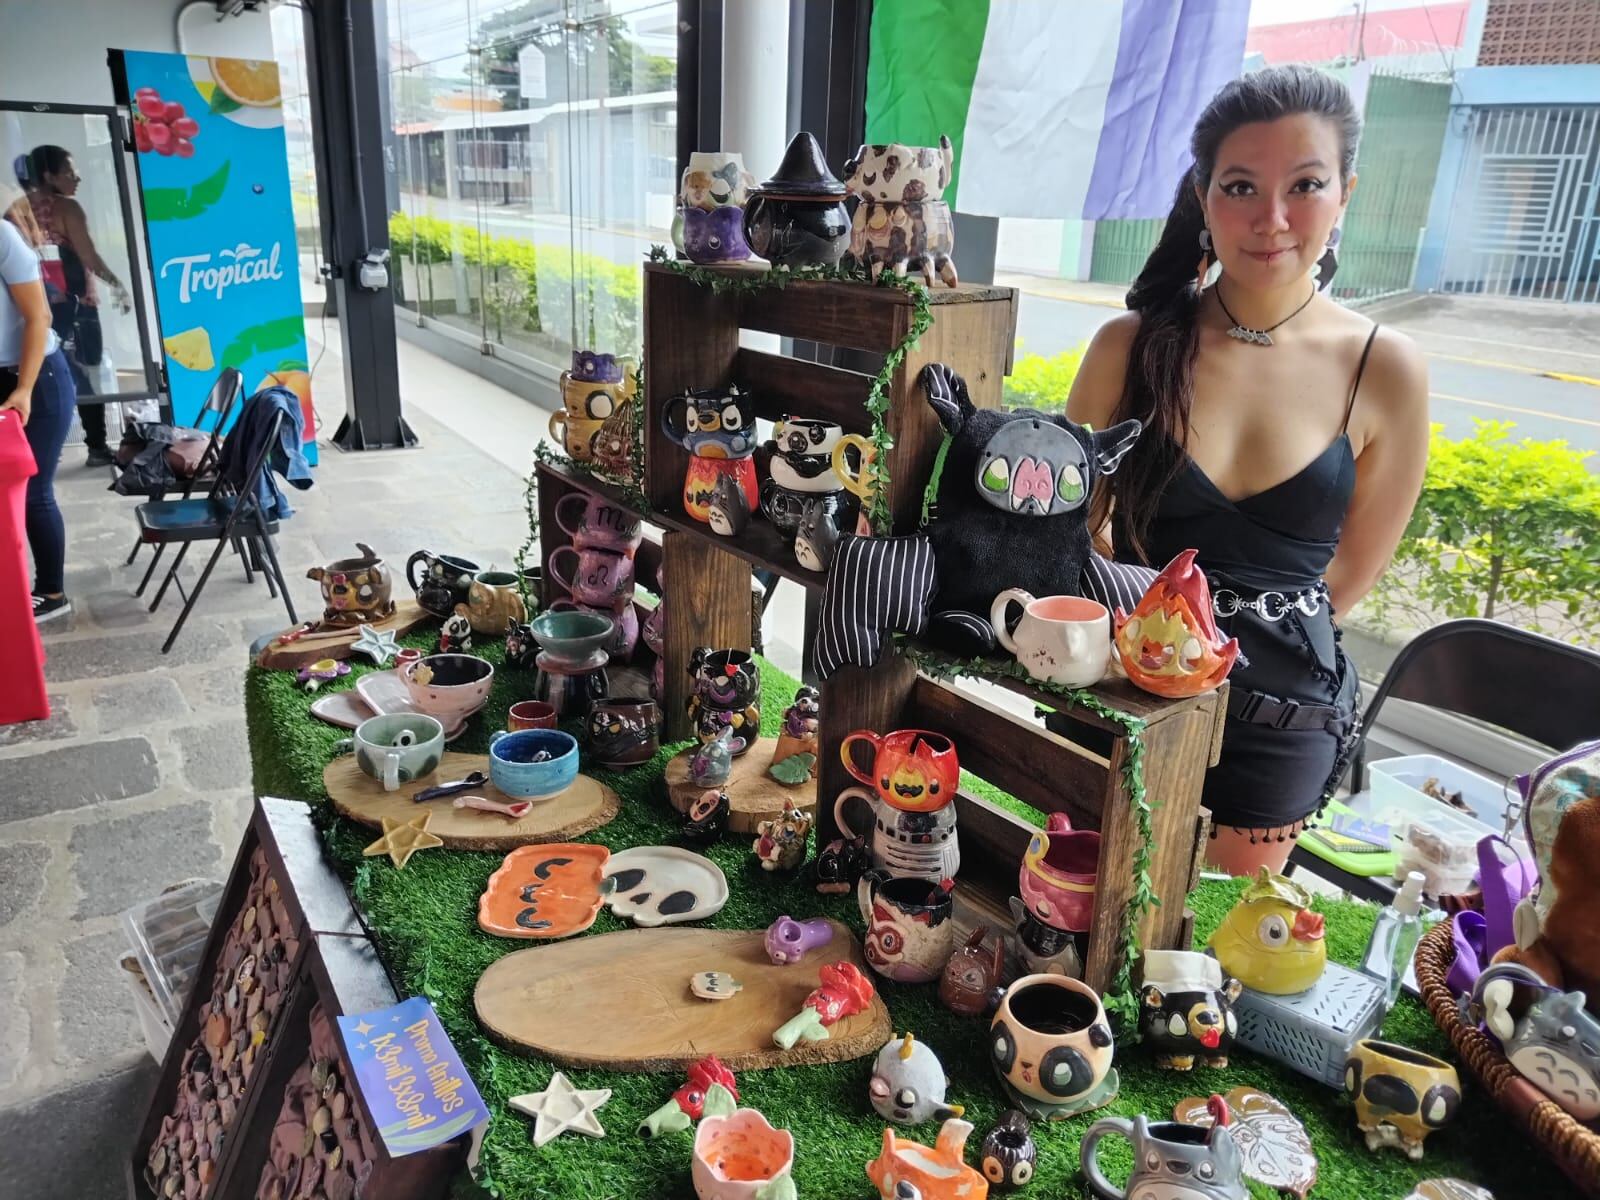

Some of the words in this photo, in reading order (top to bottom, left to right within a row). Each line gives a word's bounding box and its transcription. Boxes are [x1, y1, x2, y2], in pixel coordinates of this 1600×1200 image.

[160, 241, 283, 303] Tropical
[370, 1033, 413, 1080] 1x3mil
[405, 1019, 437, 1064] Promo
[427, 1062, 463, 1112] Anillos
[389, 1075, 437, 1130] 3x8mil
